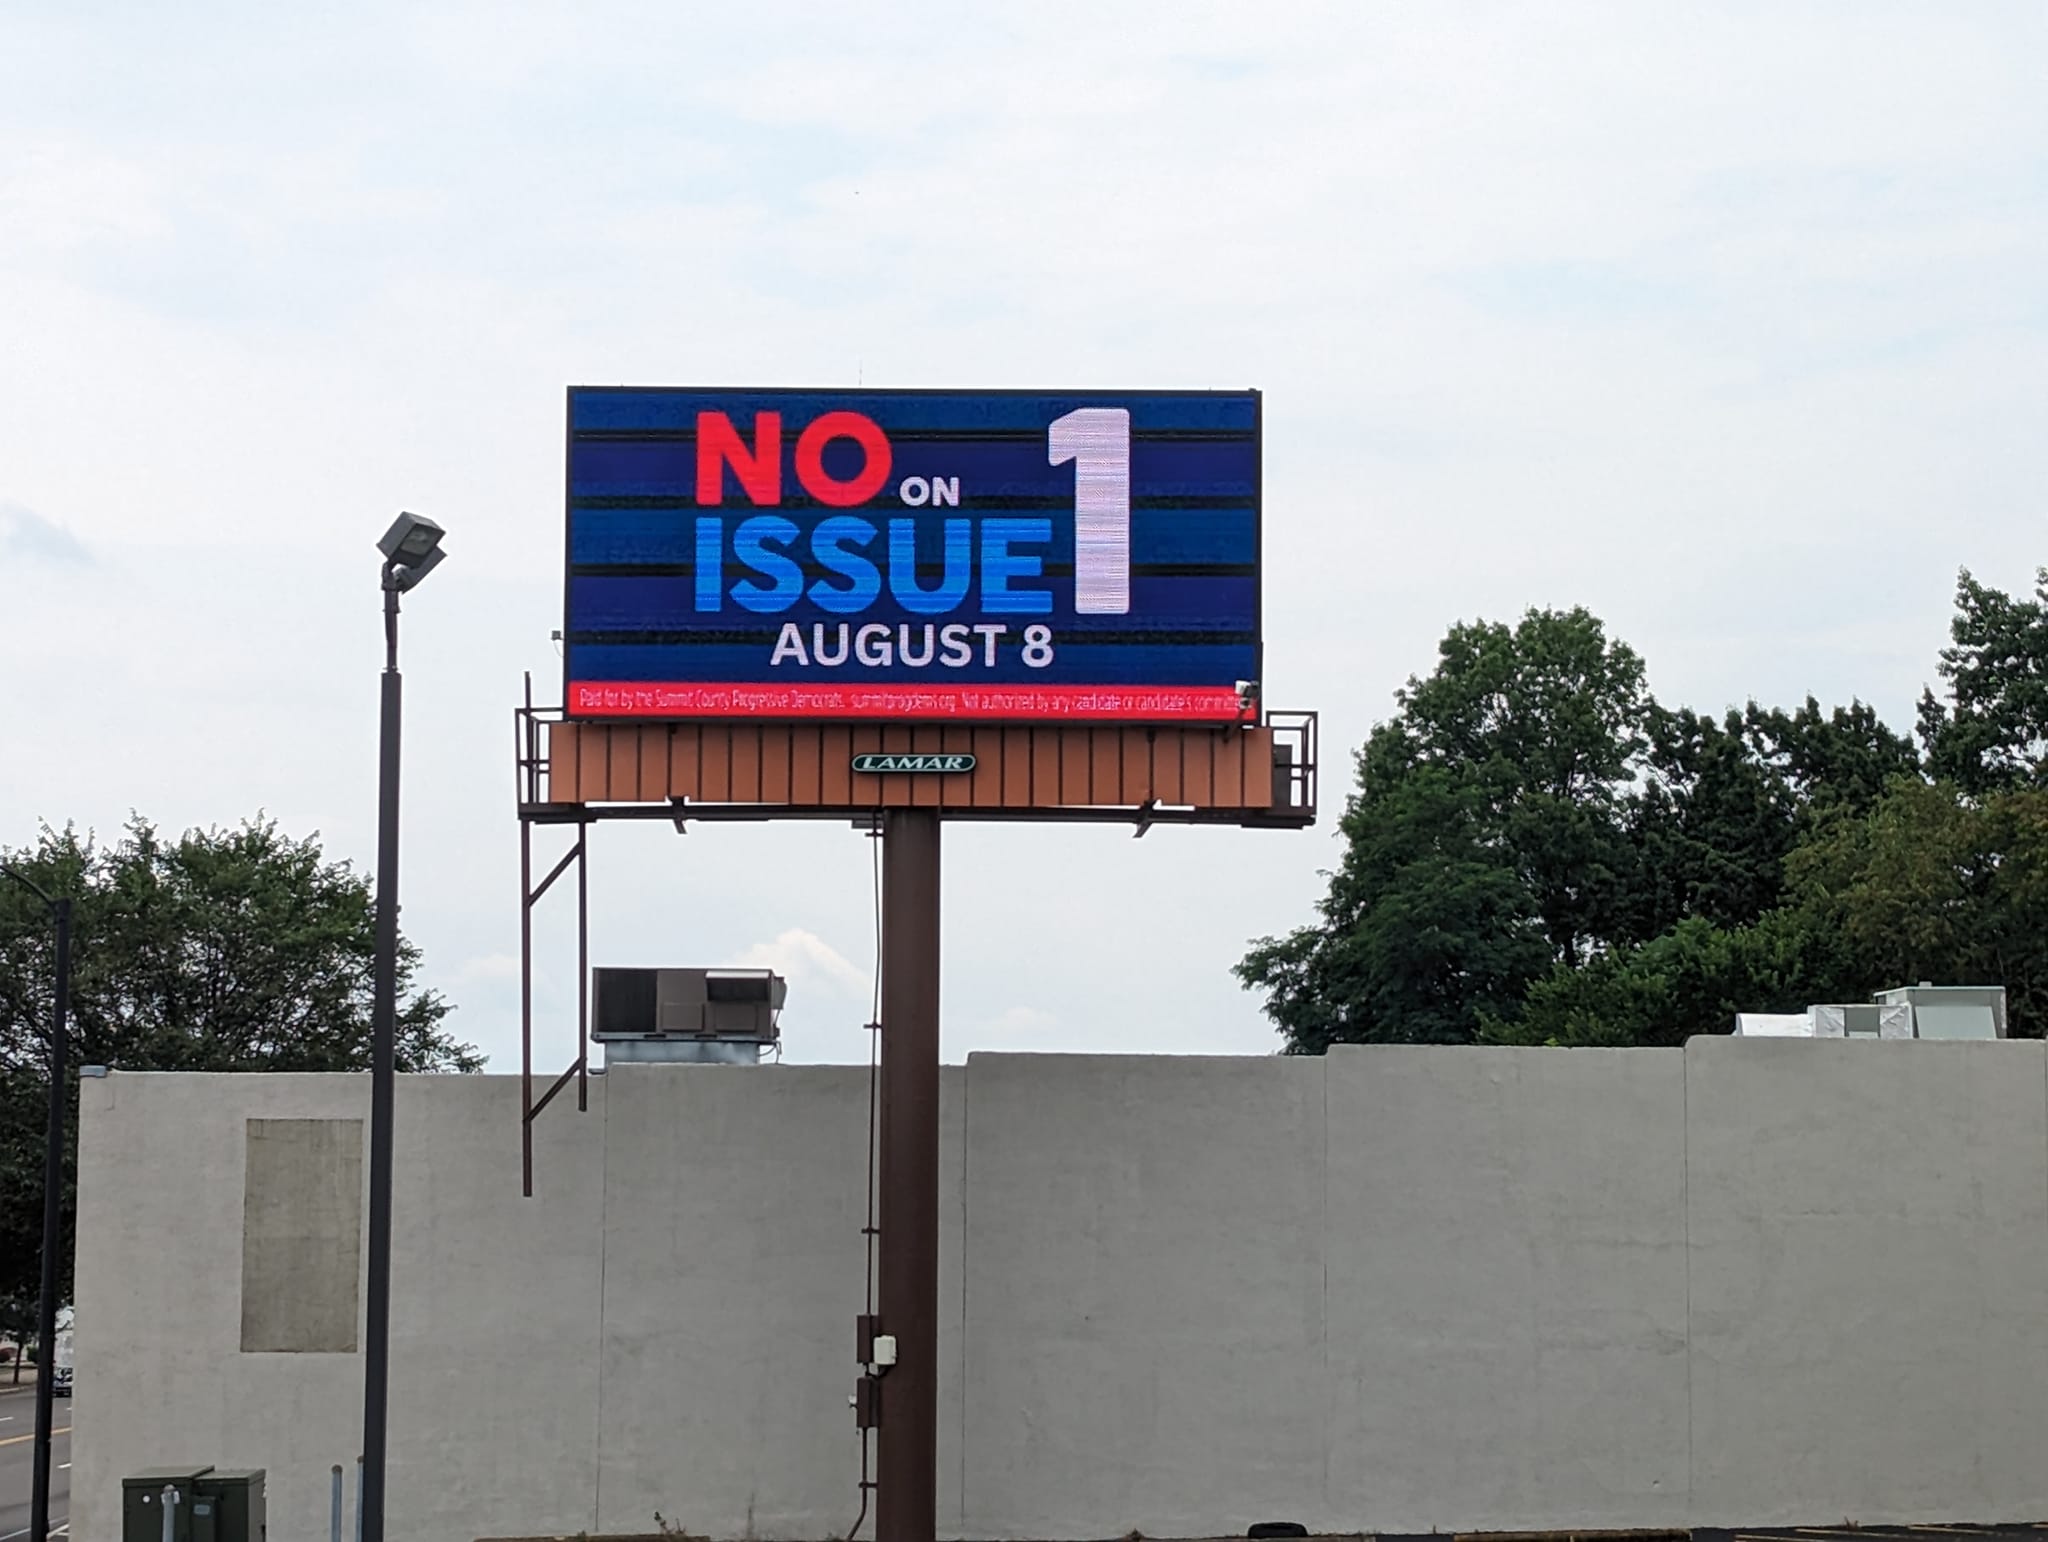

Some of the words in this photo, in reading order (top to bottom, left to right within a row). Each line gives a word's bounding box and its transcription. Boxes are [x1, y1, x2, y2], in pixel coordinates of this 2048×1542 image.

[696, 411, 893, 507] NO
[900, 476, 960, 508] ON
[1048, 407, 1131, 615] 1
[694, 515, 1053, 614] ISSUE
[769, 623, 1006, 668] AUGUST
[1022, 623, 1055, 668] 8
[862, 756, 964, 769] LAMAR
